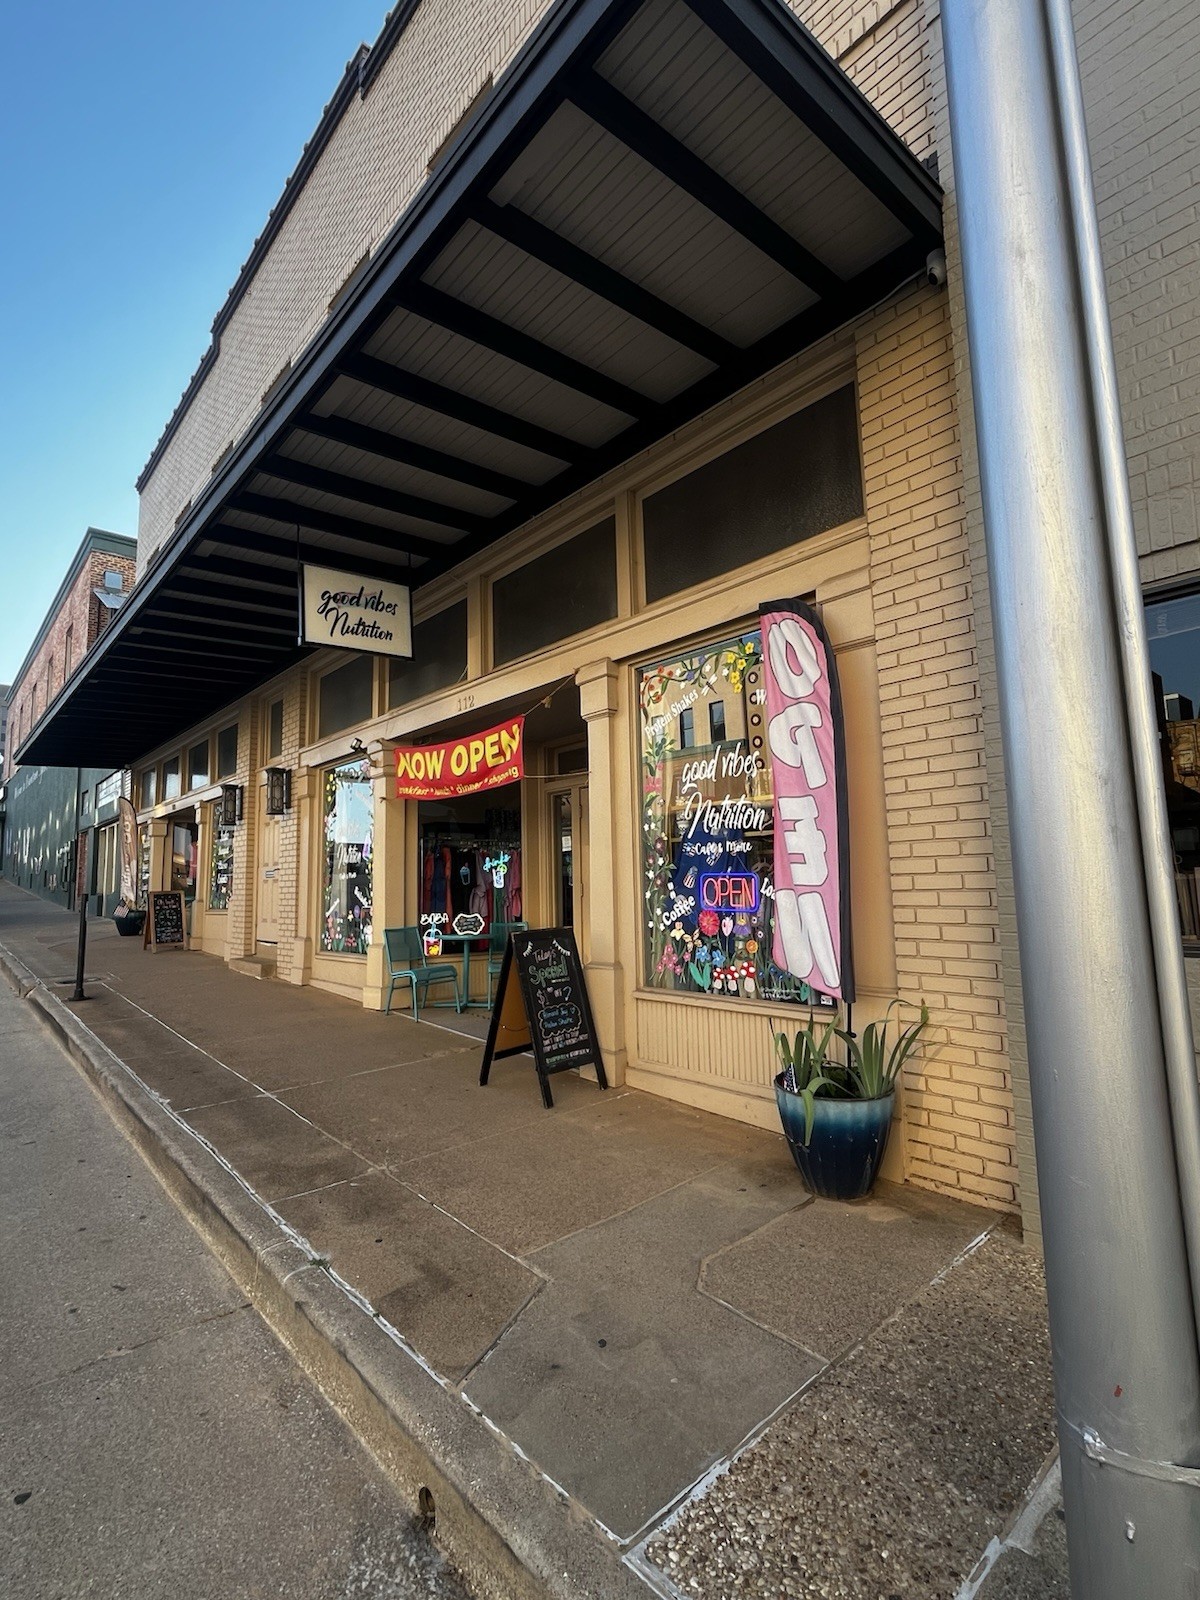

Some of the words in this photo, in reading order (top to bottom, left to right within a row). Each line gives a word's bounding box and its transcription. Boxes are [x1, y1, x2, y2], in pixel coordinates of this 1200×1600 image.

[317, 586, 364, 614] good
[364, 589, 399, 616] vibes
[324, 608, 393, 641] Nutrition
[457, 695, 475, 711] 112
[644, 712, 673, 740] Protein
[670, 689, 699, 717] Shakes
[397, 749, 446, 780] NOW
[450, 724, 520, 776] OPEN
[681, 745, 716, 793] good
[720, 742, 760, 778] vibes
[456, 781, 484, 794] dinner
[685, 792, 773, 839] Nutrition
[703, 877, 755, 908] OPEN
[420, 913, 450, 926] BOBA
[662, 896, 696, 926] Coffee
